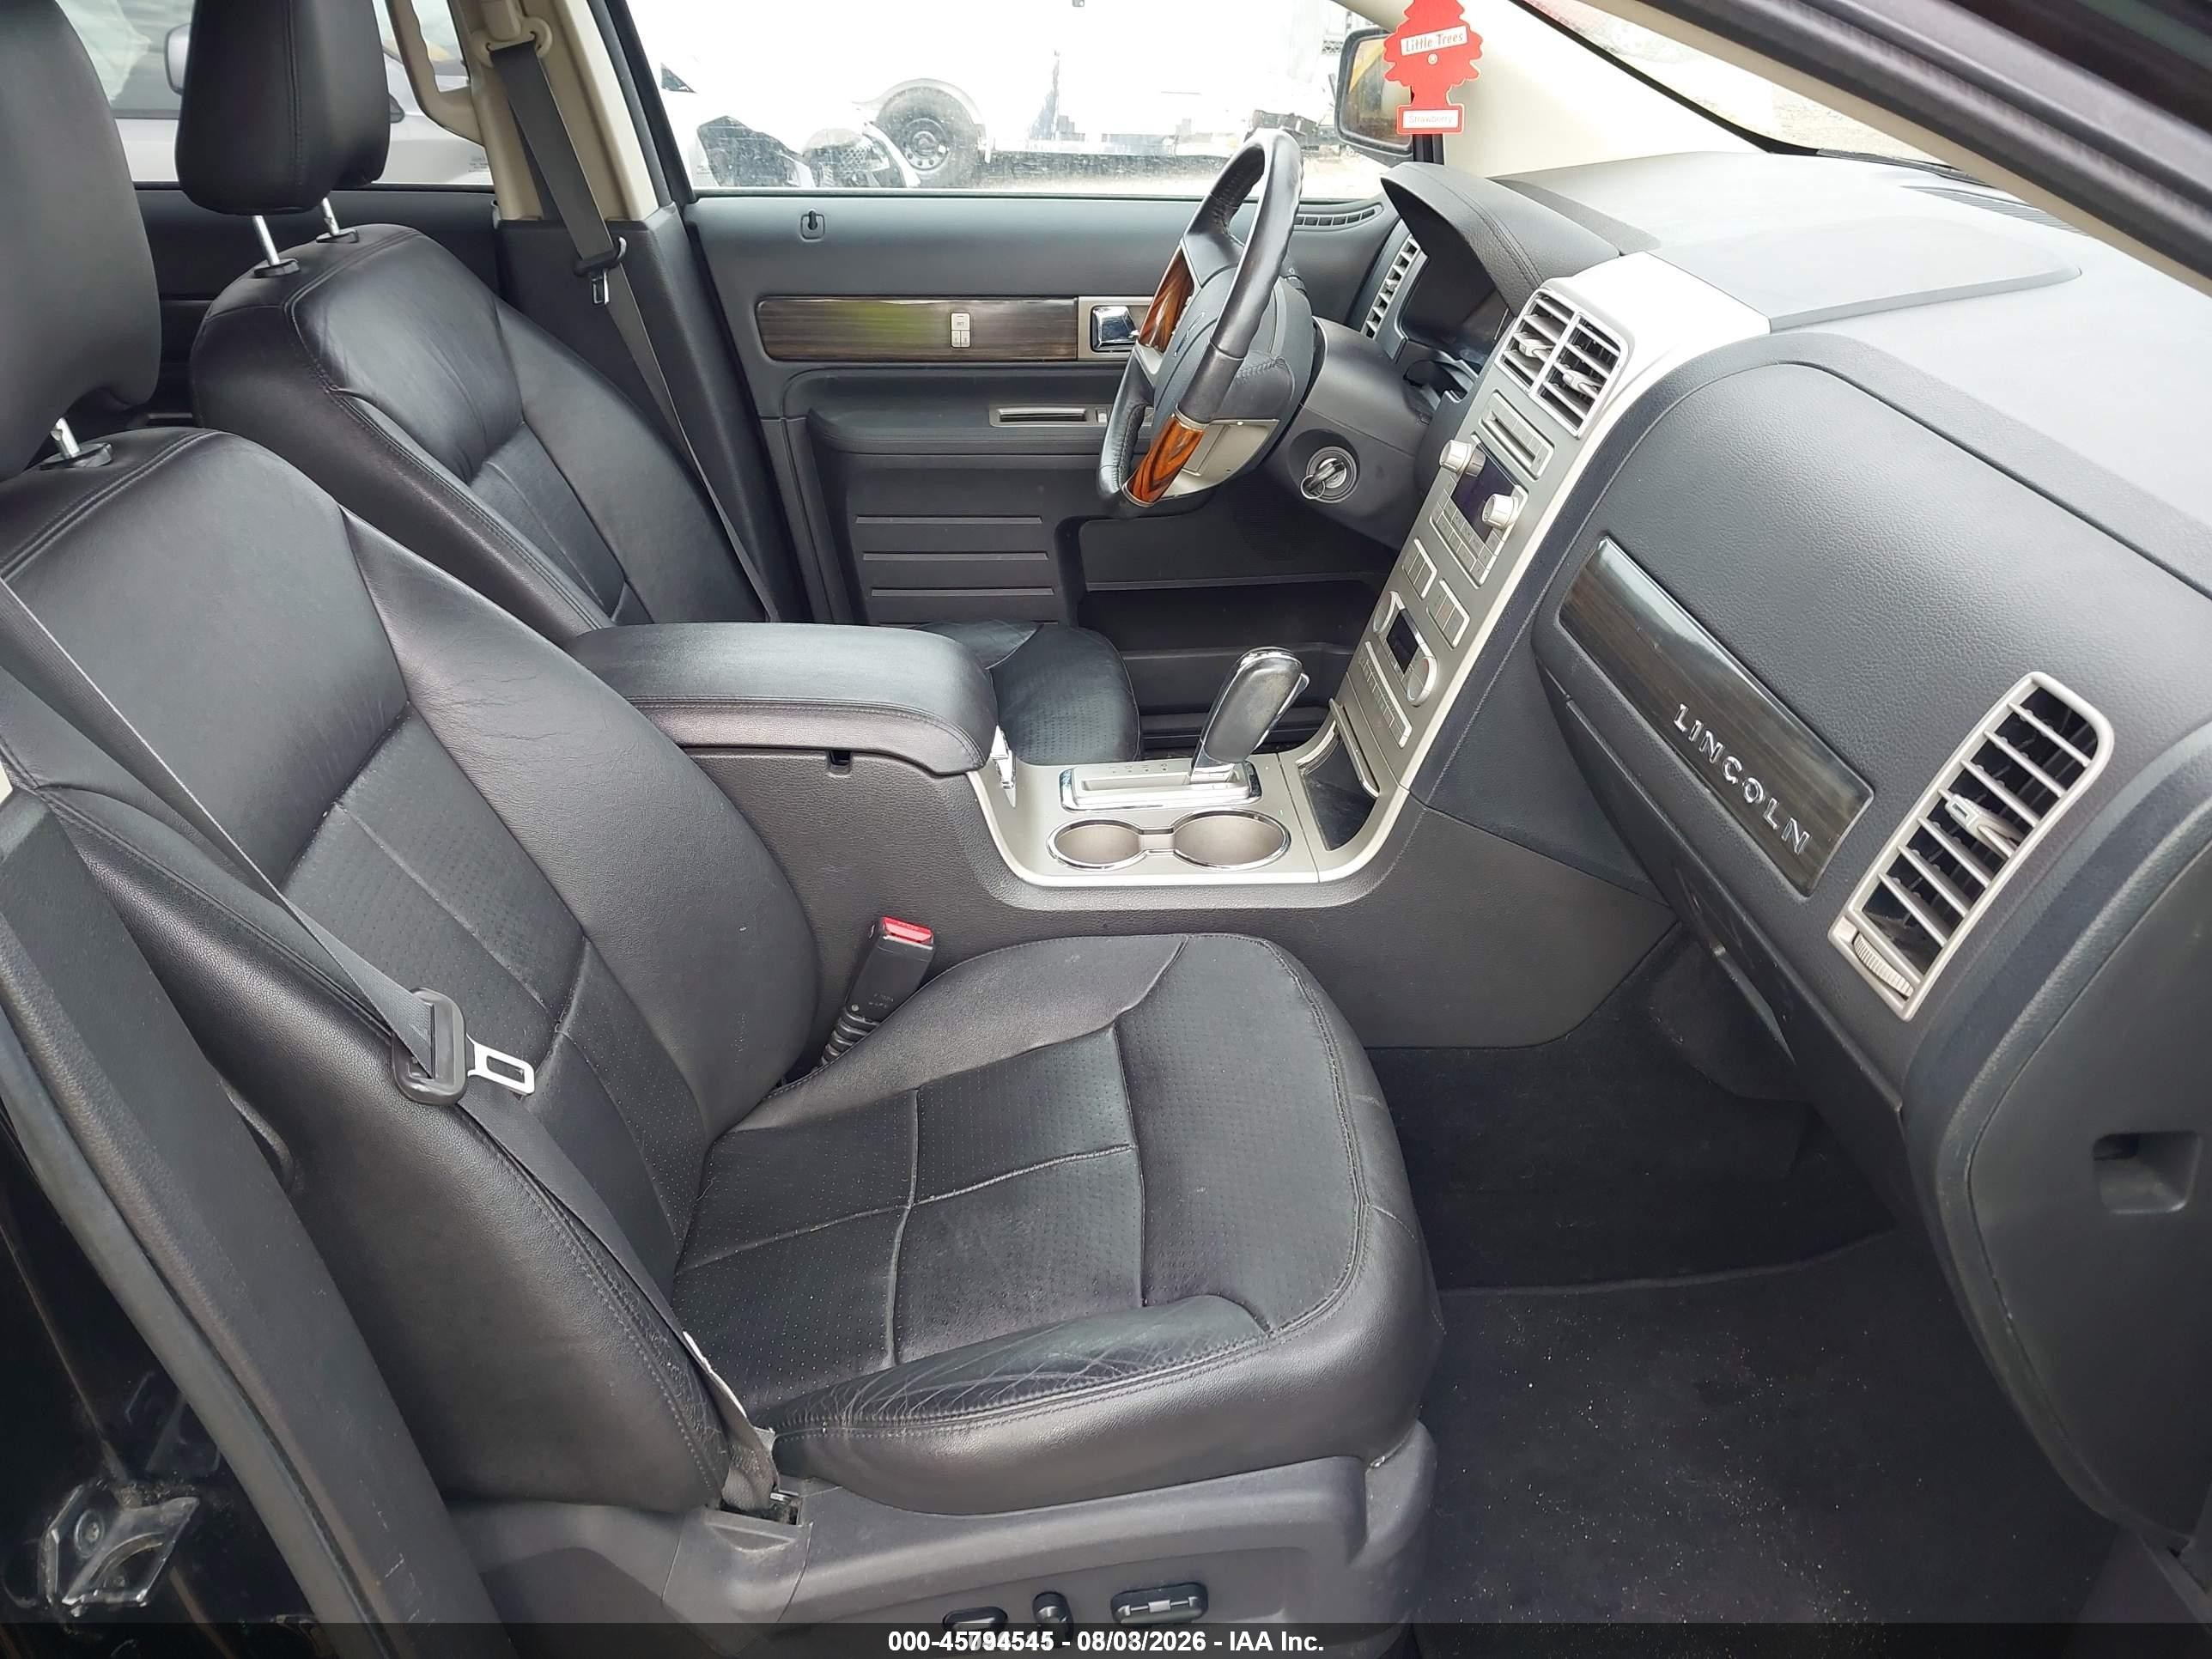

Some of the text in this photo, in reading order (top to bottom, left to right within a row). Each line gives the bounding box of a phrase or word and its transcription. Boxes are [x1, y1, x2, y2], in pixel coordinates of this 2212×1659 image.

[1406, 32, 1463, 52] Little Trees
[1674, 703, 1812, 855] LINCOLN
